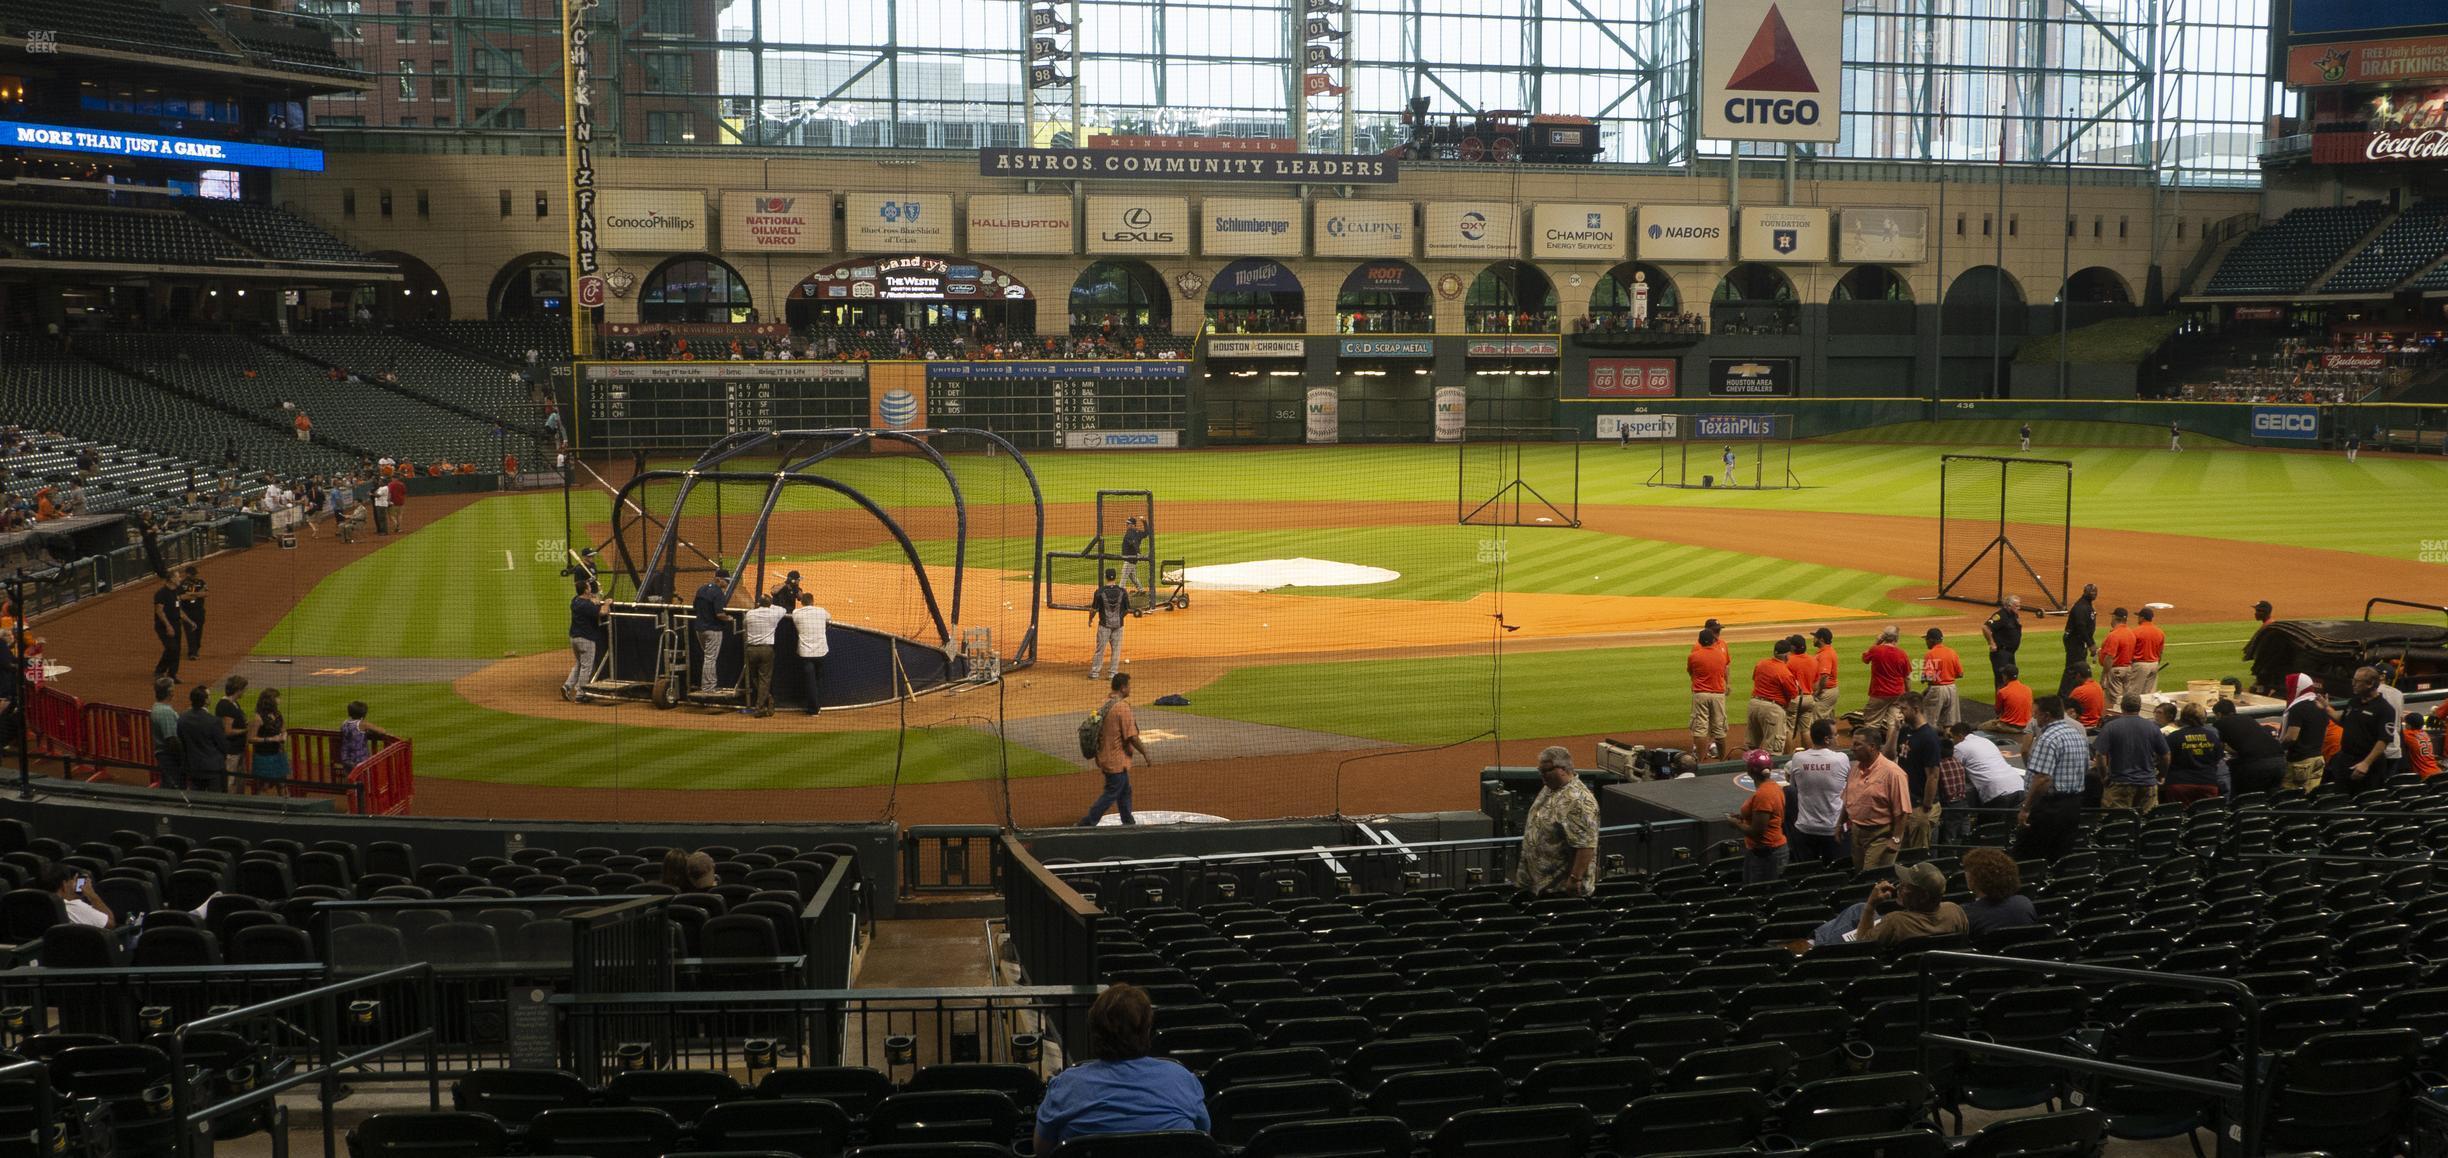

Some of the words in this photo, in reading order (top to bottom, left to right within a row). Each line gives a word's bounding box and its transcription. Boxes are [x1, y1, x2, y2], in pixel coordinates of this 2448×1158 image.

[1034, 13, 1051, 25] 86
[1310, 24, 1325, 34] 01
[1034, 41, 1051, 54] 97
[2361, 48, 2384, 59] FREE
[2386, 46, 2409, 58] Daily
[2411, 44, 2448, 57] Fantasy
[1310, 49, 1326, 61] 04
[1034, 69, 1051, 81] 98
[1310, 78, 1326, 88] 05
[1724, 98, 1820, 126] CITGO
[17, 127, 73, 146] MORE
[76, 132, 122, 150] THAN
[125, 137, 159, 154] JUST
[160, 141, 173, 154] A
[174, 143, 226, 159] GAME.
[1111, 138, 1200, 149] MINUTE
[1222, 140, 1279, 150] MAID
[996, 155, 1094, 171] ASTROS
[1105, 156, 1262, 175] COMMUNITY
[1276, 159, 1384, 177] LEADERS
[607, 216, 695, 231] ConocoPhillips
[746, 216, 806, 226] NATIONAL
[972, 219, 1070, 229] HALLIBURTON
[1460, 222, 1487, 230] OXY
[1760, 220, 1811, 228] FOUNDATION
[751, 226, 801, 236] OILWELL
[1216, 217, 1289, 236] Schlumberger
[1347, 223, 1403, 234] CALPINE
[1102, 232, 1174, 242] LEXUS
[1546, 229, 1613, 241] CHAMPION
[1665, 227, 1721, 238] NABORS
[757, 236, 796, 245] VARCO
[1546, 242, 1577, 250] ENERGY
[1235, 264, 1278, 287] Montejo
[1368, 267, 1405, 279] ROOT
[1213, 342, 1250, 352] HOUSTON
[1257, 342, 1300, 352] CHRONICLE
[1346, 343, 1354, 353] C
[1355, 344, 1362, 353] &
[1363, 343, 1372, 353] D
[1375, 343, 1401, 353] SCRAP
[1402, 343, 1427, 353] METAL
[2326, 355, 2384, 368] Budweiser
[551, 367, 572, 376] 315
[618, 368, 635, 376] bmc
[726, 368, 742, 376] bmc
[829, 368, 844, 376] bmc
[1598, 376, 1612, 386] 66
[1624, 376, 1638, 386] 66
[1651, 376, 1665, 386] 66
[611, 402, 625, 410] ATL
[1275, 410, 1296, 419] 362
[1698, 418, 1770, 434] TexanPlus
[2254, 413, 2317, 431] GEICO
[1105, 435, 1159, 445] mazda
[1803, 763, 1831, 771] WELCH
